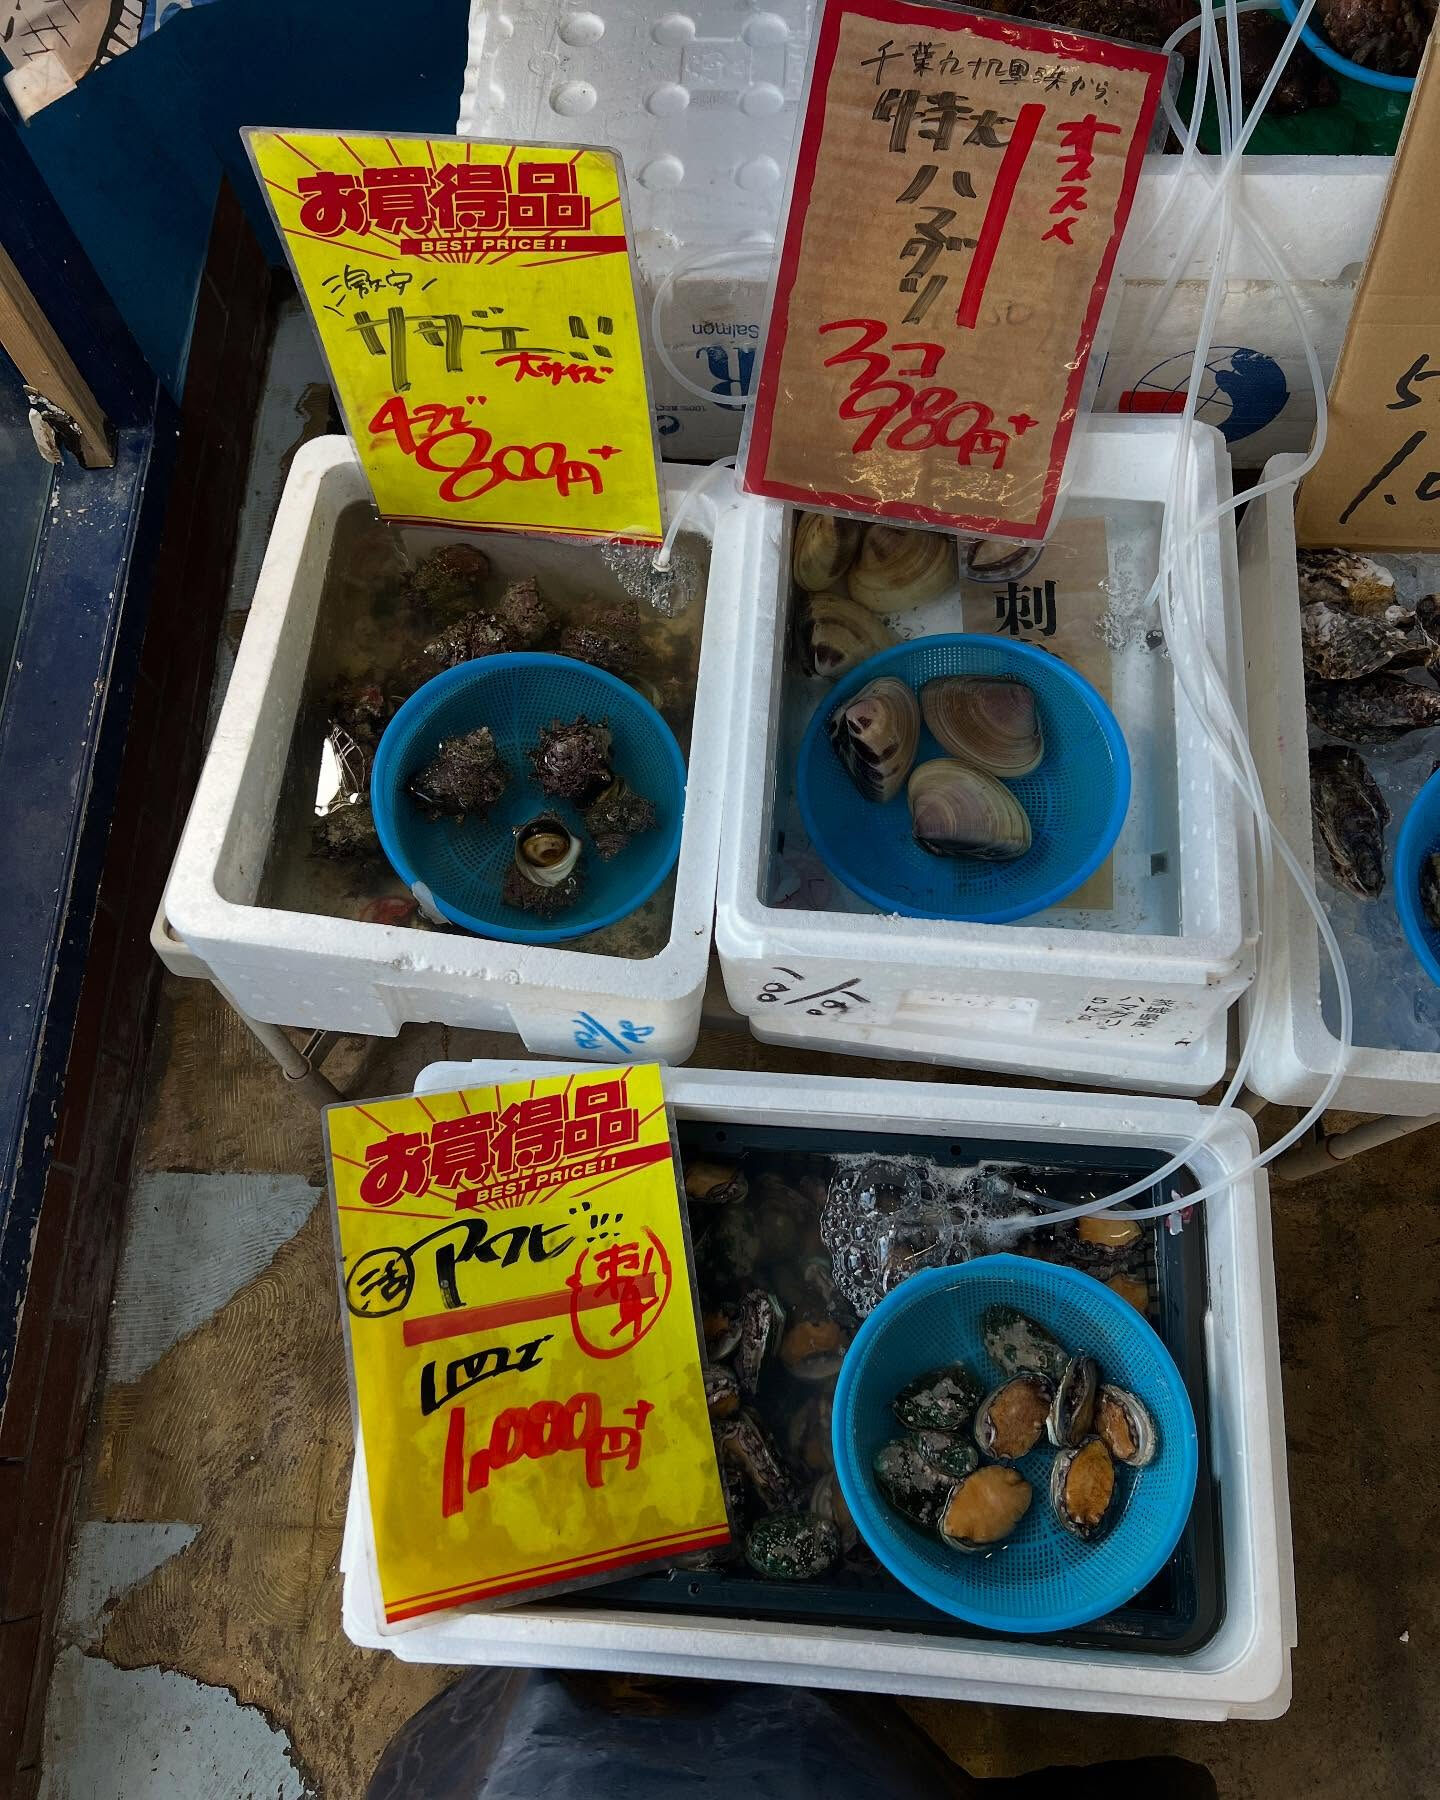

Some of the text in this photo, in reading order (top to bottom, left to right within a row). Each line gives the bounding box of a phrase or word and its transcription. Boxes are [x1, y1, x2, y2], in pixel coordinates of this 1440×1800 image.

[297, 162, 591, 237] お買得品
[421, 239, 568, 252] BEST PRICE!!
[692, 324, 760, 339] Salmon
[358, 1079, 640, 1207] お買得品
[476, 1156, 617, 1202] BEST PRICE!!
